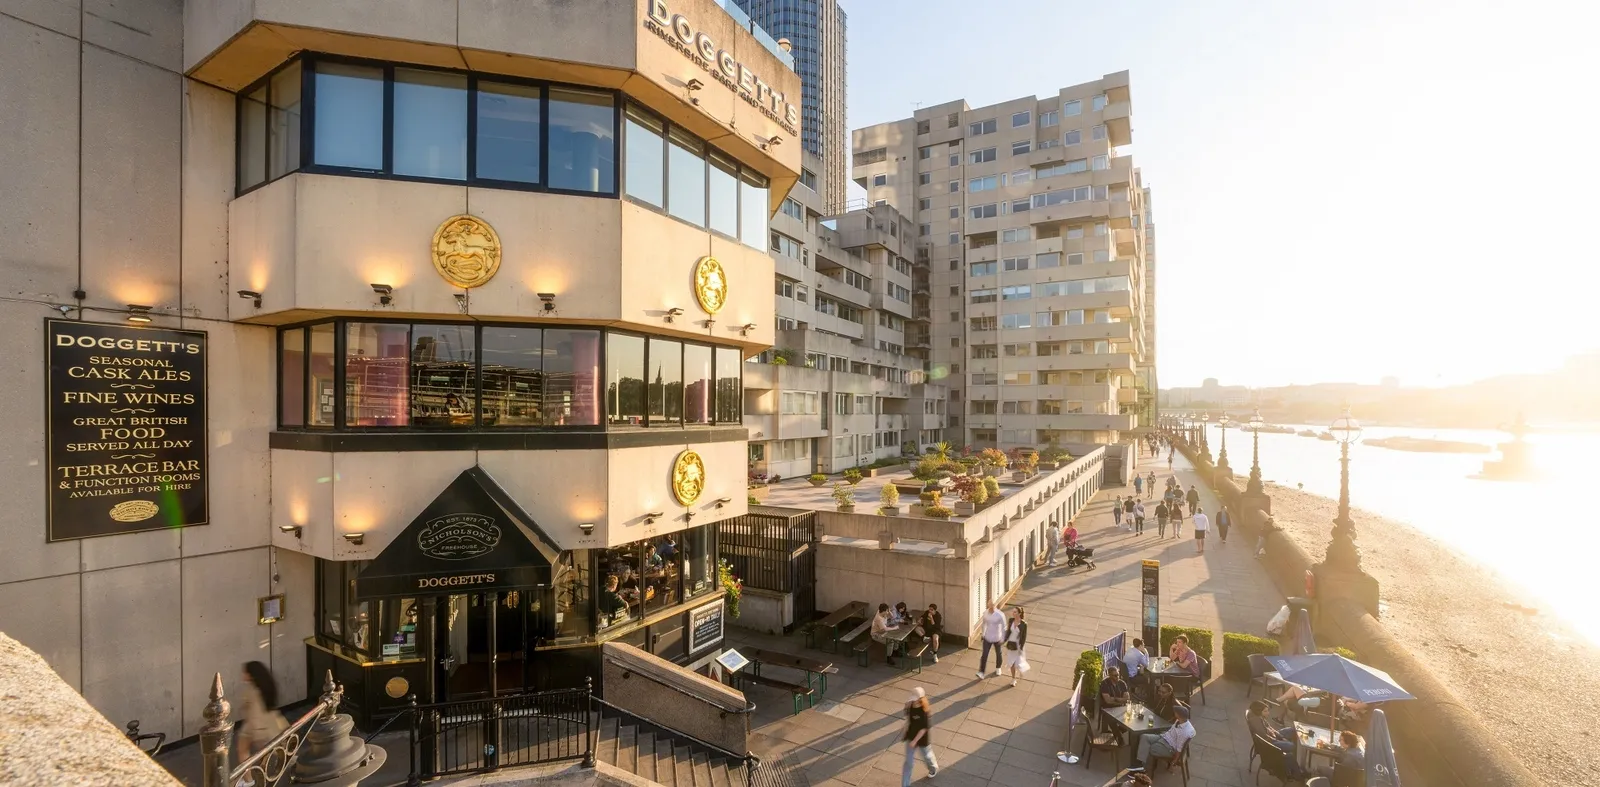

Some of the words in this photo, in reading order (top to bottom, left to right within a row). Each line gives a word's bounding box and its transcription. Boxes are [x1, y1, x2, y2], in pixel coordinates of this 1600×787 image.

[647, 0, 798, 127] DOGGETT'S
[645, 20, 710, 72] RIVERSIDE
[710, 69, 738, 94] BARS
[740, 91, 759, 108] AND
[759, 105, 798, 138] TERRACES
[56, 334, 200, 355] DOGGETT'S
[89, 355, 174, 368] SEASONAL
[68, 366, 132, 380] CASK
[139, 369, 192, 382] ALES
[63, 391, 118, 404] FINE
[123, 392, 195, 405] WINES
[73, 416, 126, 427] GREAT
[130, 416, 188, 426] BRITISH
[101, 427, 166, 440] FOOD
[66, 441, 130, 452] SERVED
[133, 440, 160, 450] ALL
[163, 439, 193, 449] DAY
[57, 461, 159, 478] TERRACE
[162, 459, 200, 473] BAR
[59, 480, 71, 490] &
[75, 474, 151, 489] FUNCTION
[153, 472, 201, 484] ROOMS
[69, 487, 134, 499] AVAILABLE
[138, 484, 161, 493] FOR
[165, 483, 192, 492] HIRE
[445, 516, 461, 524] EST.
[427, 528, 492, 545] NICHOLSON'S
[418, 573, 495, 588] DOGGETT'S
